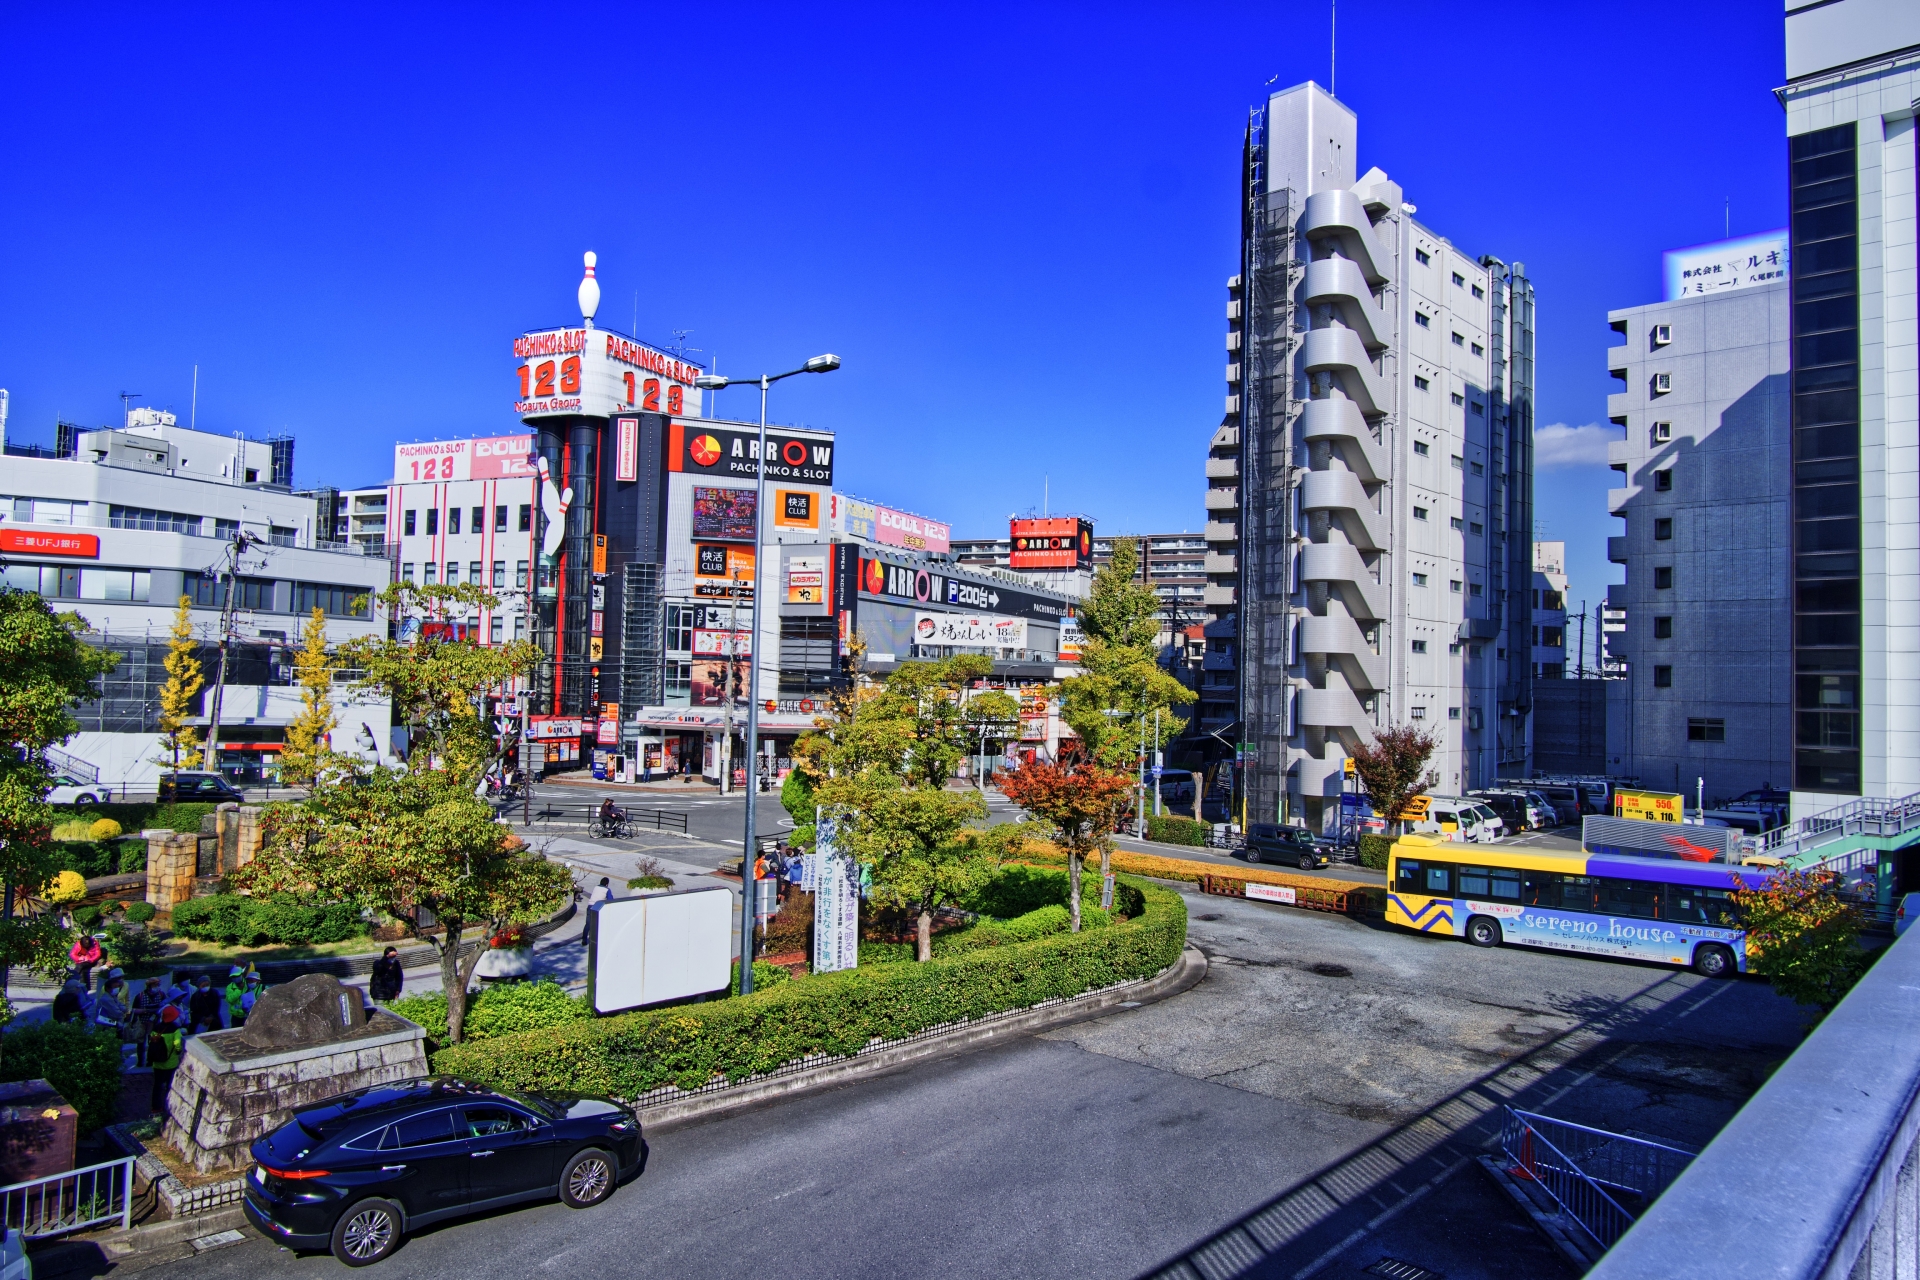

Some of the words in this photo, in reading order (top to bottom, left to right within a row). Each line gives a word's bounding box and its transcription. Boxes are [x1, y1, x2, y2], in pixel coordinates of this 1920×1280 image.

[1683, 264, 1722, 279] 株式会社
[1750, 270, 1784, 283] 八尾駅前
[513, 332, 557, 358] PACHINKO
[557, 339, 563, 349] &
[563, 330, 587, 352] SLOT
[606, 334, 664, 374] PACHINKO
[666, 361, 672, 378] &
[673, 360, 699, 386] SLOT
[516, 355, 582, 398] 123
[623, 371, 684, 416] 123
[400, 445, 439, 457] PACHINKO
[445, 443, 466, 453] SLOT
[731, 438, 831, 466] ARROW
[410, 456, 454, 481] 123
[730, 463, 790, 477] PACHNKO
[792, 468, 800, 478] &
[803, 470, 831, 480] SLOT
[788, 496, 807, 507] 快活
[788, 507, 807, 515] CLUB
[880, 511, 921, 535] BOWL
[923, 522, 947, 541] 123
[15, 536, 81, 549] 三菱UFJ銀行
[903, 534, 927, 550] 年中無休
[1029, 537, 1070, 550] ARROW
[702, 550, 723, 562] 快活
[702, 562, 723, 571] CLUB
[795, 576, 816, 584] カラオケ
[888, 566, 943, 602] ARROW
[959, 584, 988, 608] 200台
[1033, 603, 1055, 614] PACHINKO
[780, 699, 825, 713] ARROW
[1525, 914, 1598, 934] sereno
[1608, 918, 1676, 943] house
[1562, 933, 1605, 943] セレーノハウス
[1606, 938, 1633, 947] 株式会社
